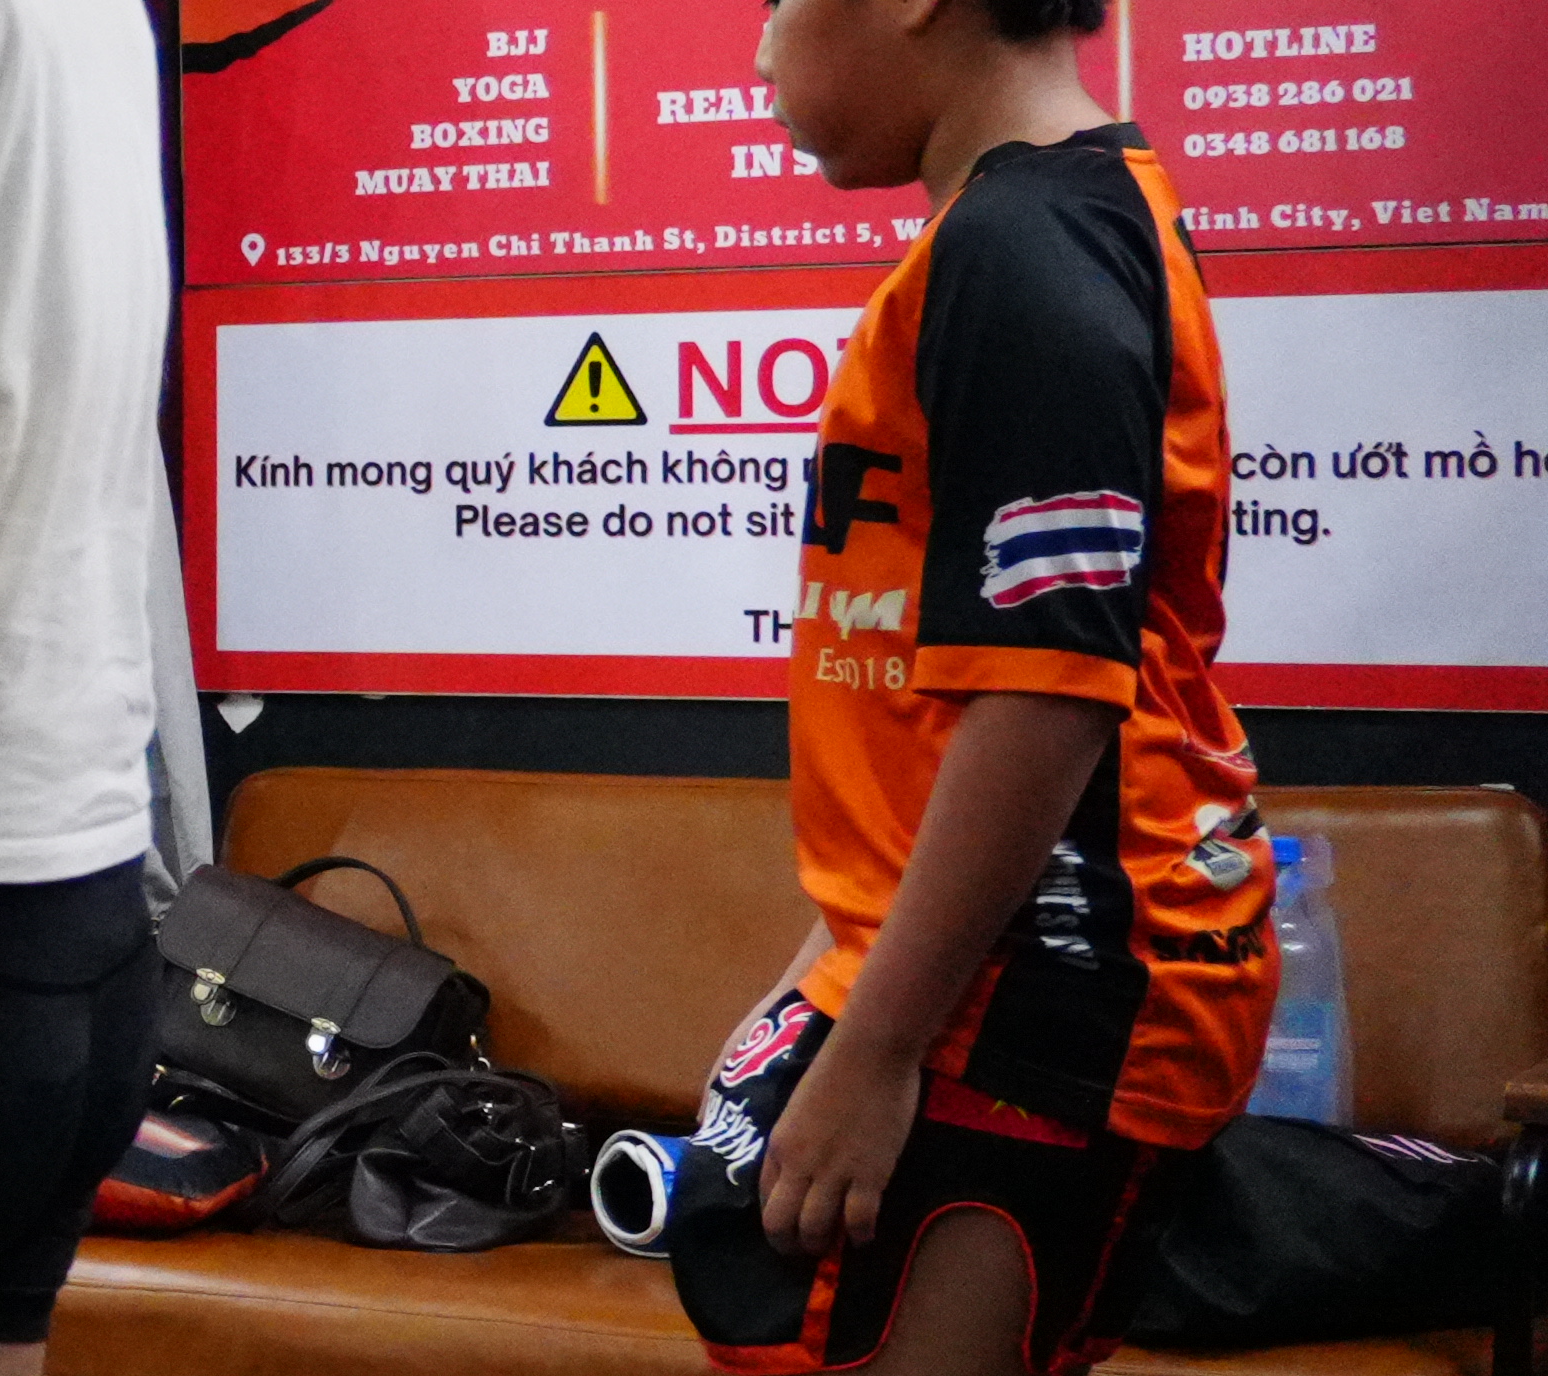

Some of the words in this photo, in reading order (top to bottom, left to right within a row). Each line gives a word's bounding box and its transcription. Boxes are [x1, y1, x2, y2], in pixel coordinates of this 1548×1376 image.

[486, 28, 549, 59] BJJ
[1183, 24, 1376, 62] HOTLINE
[453, 72, 550, 104] YOGA
[657, 85, 776, 125] REAL
[1183, 83, 1270, 110] 0938
[1278, 80, 1345, 106] 286
[1352, 76, 1412, 103] 021
[410, 117, 550, 151] BOXING
[1183, 131, 1270, 158] 0348
[1278, 129, 1336, 155] 681
[1344, 125, 1406, 151] 168
[355, 164, 457, 197] MUAY
[463, 160, 550, 191] THAI
[731, 143, 784, 179] IN
[1271, 200, 1362, 232] City,
[1372, 197, 1452, 226] Viet
[1463, 196, 1548, 222] Nam
[276, 241, 351, 267] 133/3
[359, 237, 477, 266] Nguyen
[487, 232, 541, 259] Chi
[551, 229, 656, 256] Thanh
[662, 226, 706, 255] St,
[714, 221, 847, 251] District
[855, 219, 883, 249] 5,
[234, 454, 314, 489] Kính
[326, 458, 433, 495] mong
[445, 453, 516, 494] quý
[527, 450, 648, 486] khách
[661, 448, 789, 491] không
[1230, 443, 1316, 481] còn
[1332, 439, 1411, 480] ướt
[1423, 428, 1499, 480] mồ
[456, 503, 589, 539] Please
[602, 503, 653, 537] do
[665, 505, 734, 537] not
[745, 502, 795, 536] sit
[1231, 500, 1333, 545] ting.
